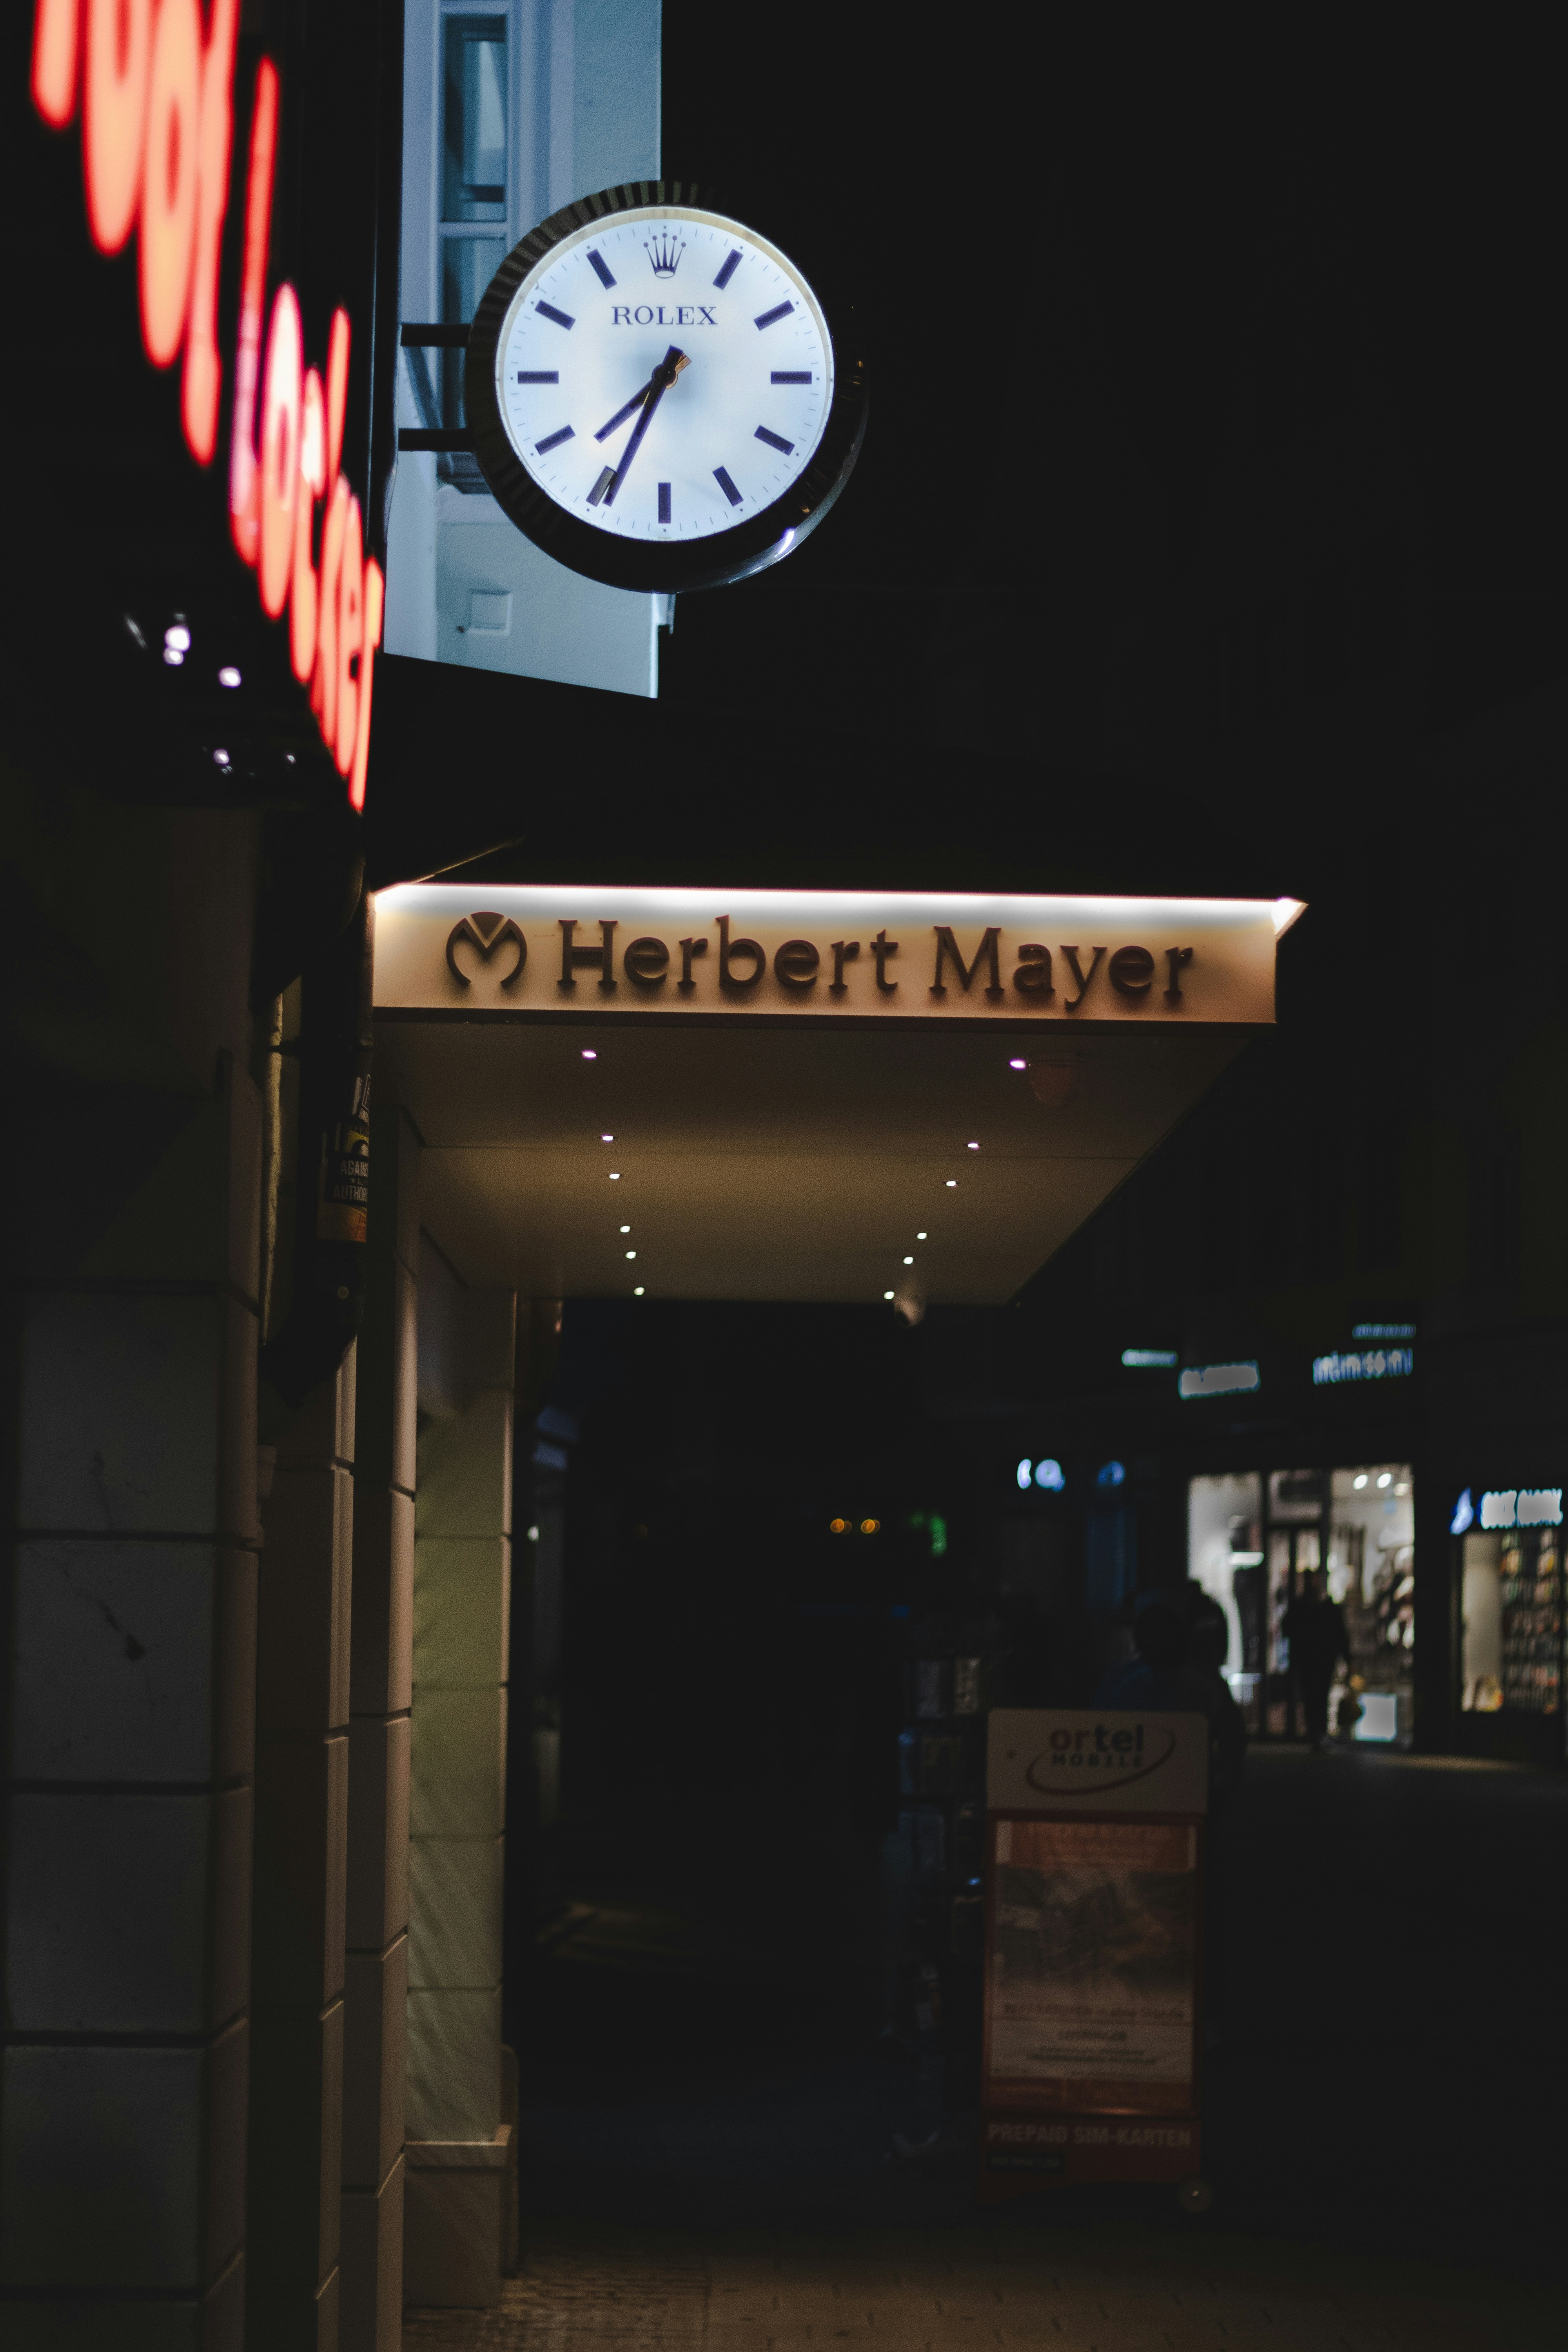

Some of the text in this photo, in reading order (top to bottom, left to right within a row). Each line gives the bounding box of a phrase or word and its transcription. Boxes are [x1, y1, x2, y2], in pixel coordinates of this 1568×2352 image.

[611, 306, 718, 325] ROLEX
[229, 54, 385, 814] Locker
[557, 914, 1194, 1011] Herbert Mayer
[1050, 1724, 1144, 1753] ortel
[1052, 1753, 1144, 1768] MOBILE
[987, 2123, 1191, 2148] PREPAID SIM-KARTEN
